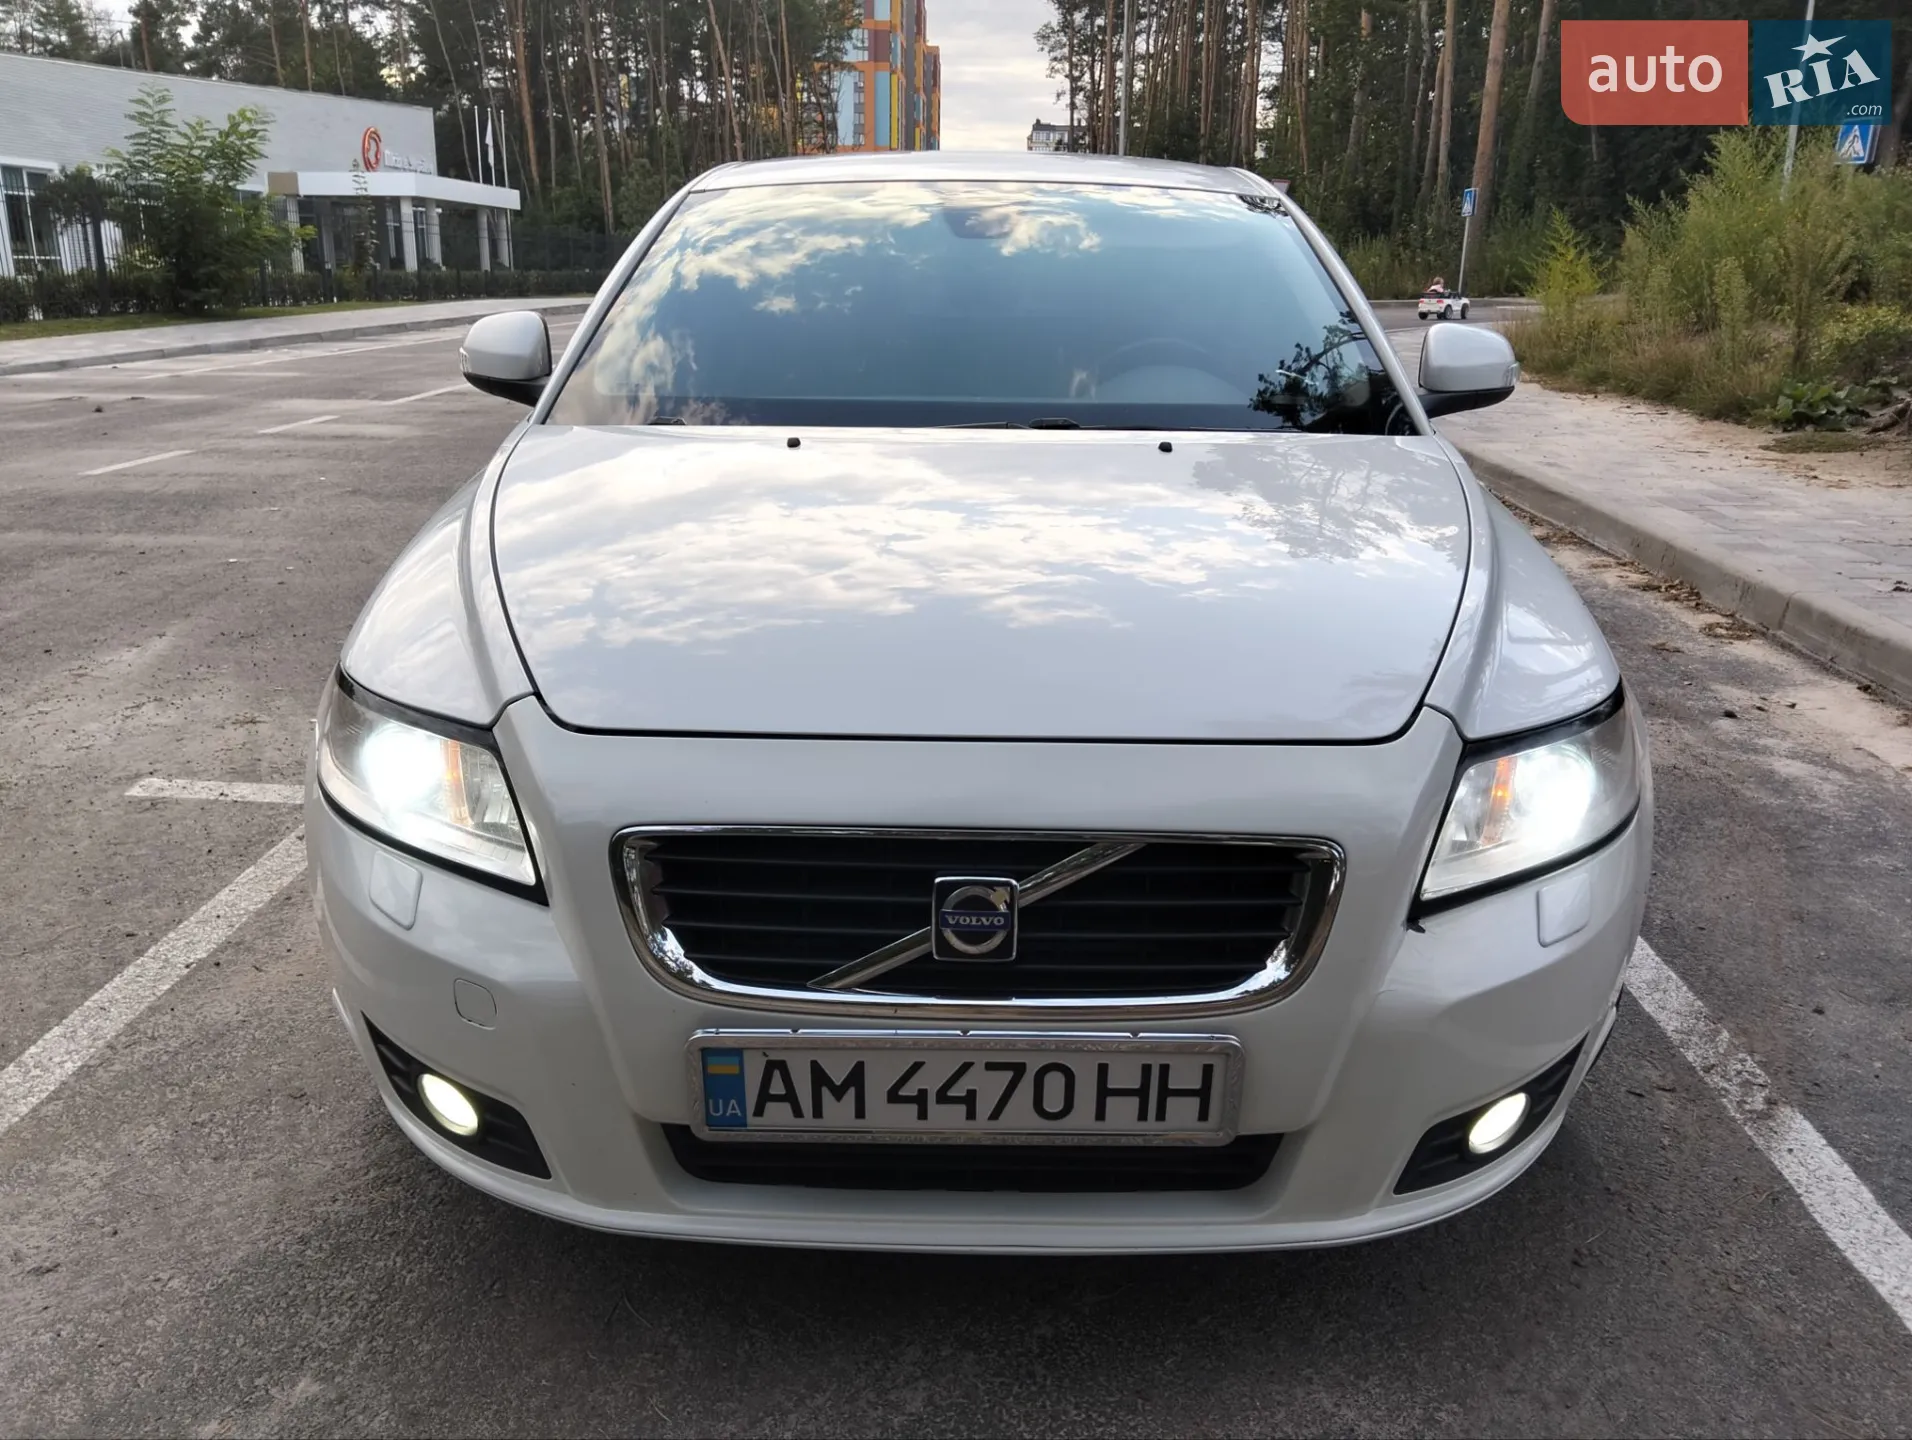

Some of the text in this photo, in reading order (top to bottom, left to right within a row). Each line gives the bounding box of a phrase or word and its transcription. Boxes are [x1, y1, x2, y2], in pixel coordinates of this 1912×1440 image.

[944, 914, 1005, 926] VOLVO
[752, 1059, 1214, 1122] AM 4470 HH
[708, 1098, 742, 1117] UA
